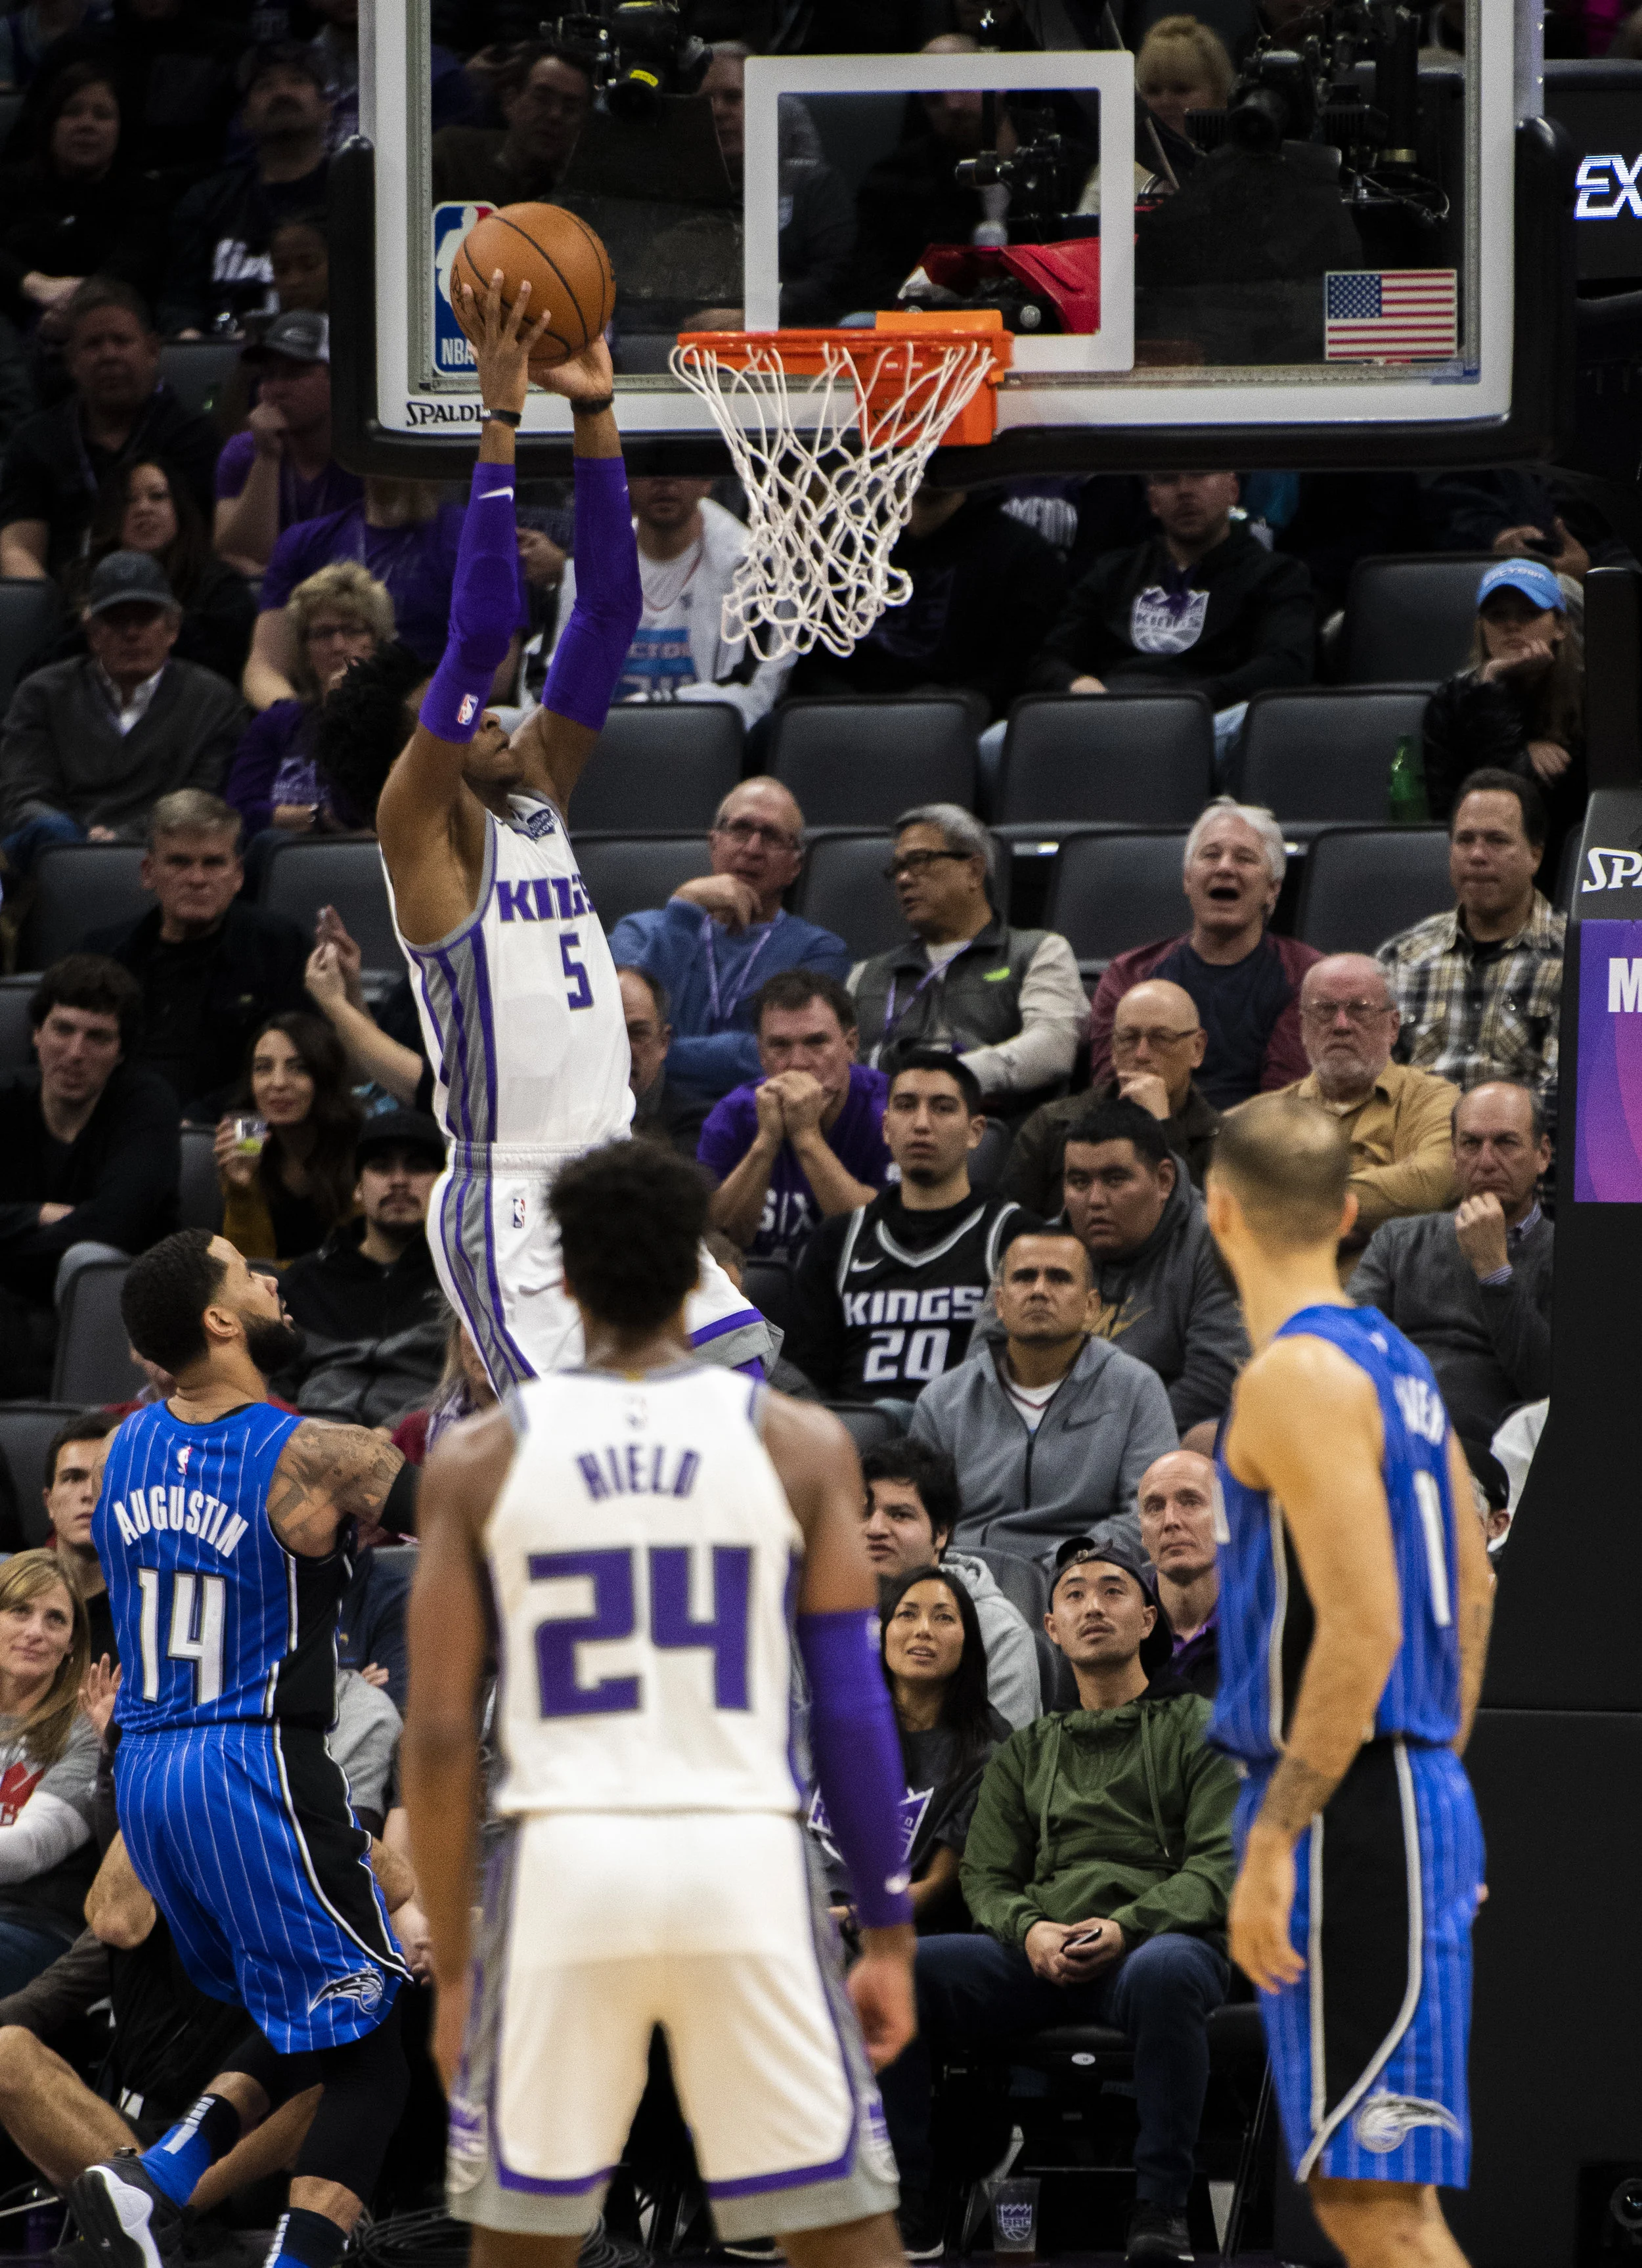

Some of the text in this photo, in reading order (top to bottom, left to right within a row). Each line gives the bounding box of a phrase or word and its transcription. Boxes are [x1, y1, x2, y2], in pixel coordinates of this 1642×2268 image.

[406, 401, 485, 428] SPALDI
[559, 931, 594, 1012] 5
[843, 1286, 984, 1327] KINGS
[863, 1328, 950, 1382] 20
[113, 1485, 249, 1559] AUGUSTIN
[137, 1565, 227, 1708] 14
[527, 1544, 757, 1721] 24
